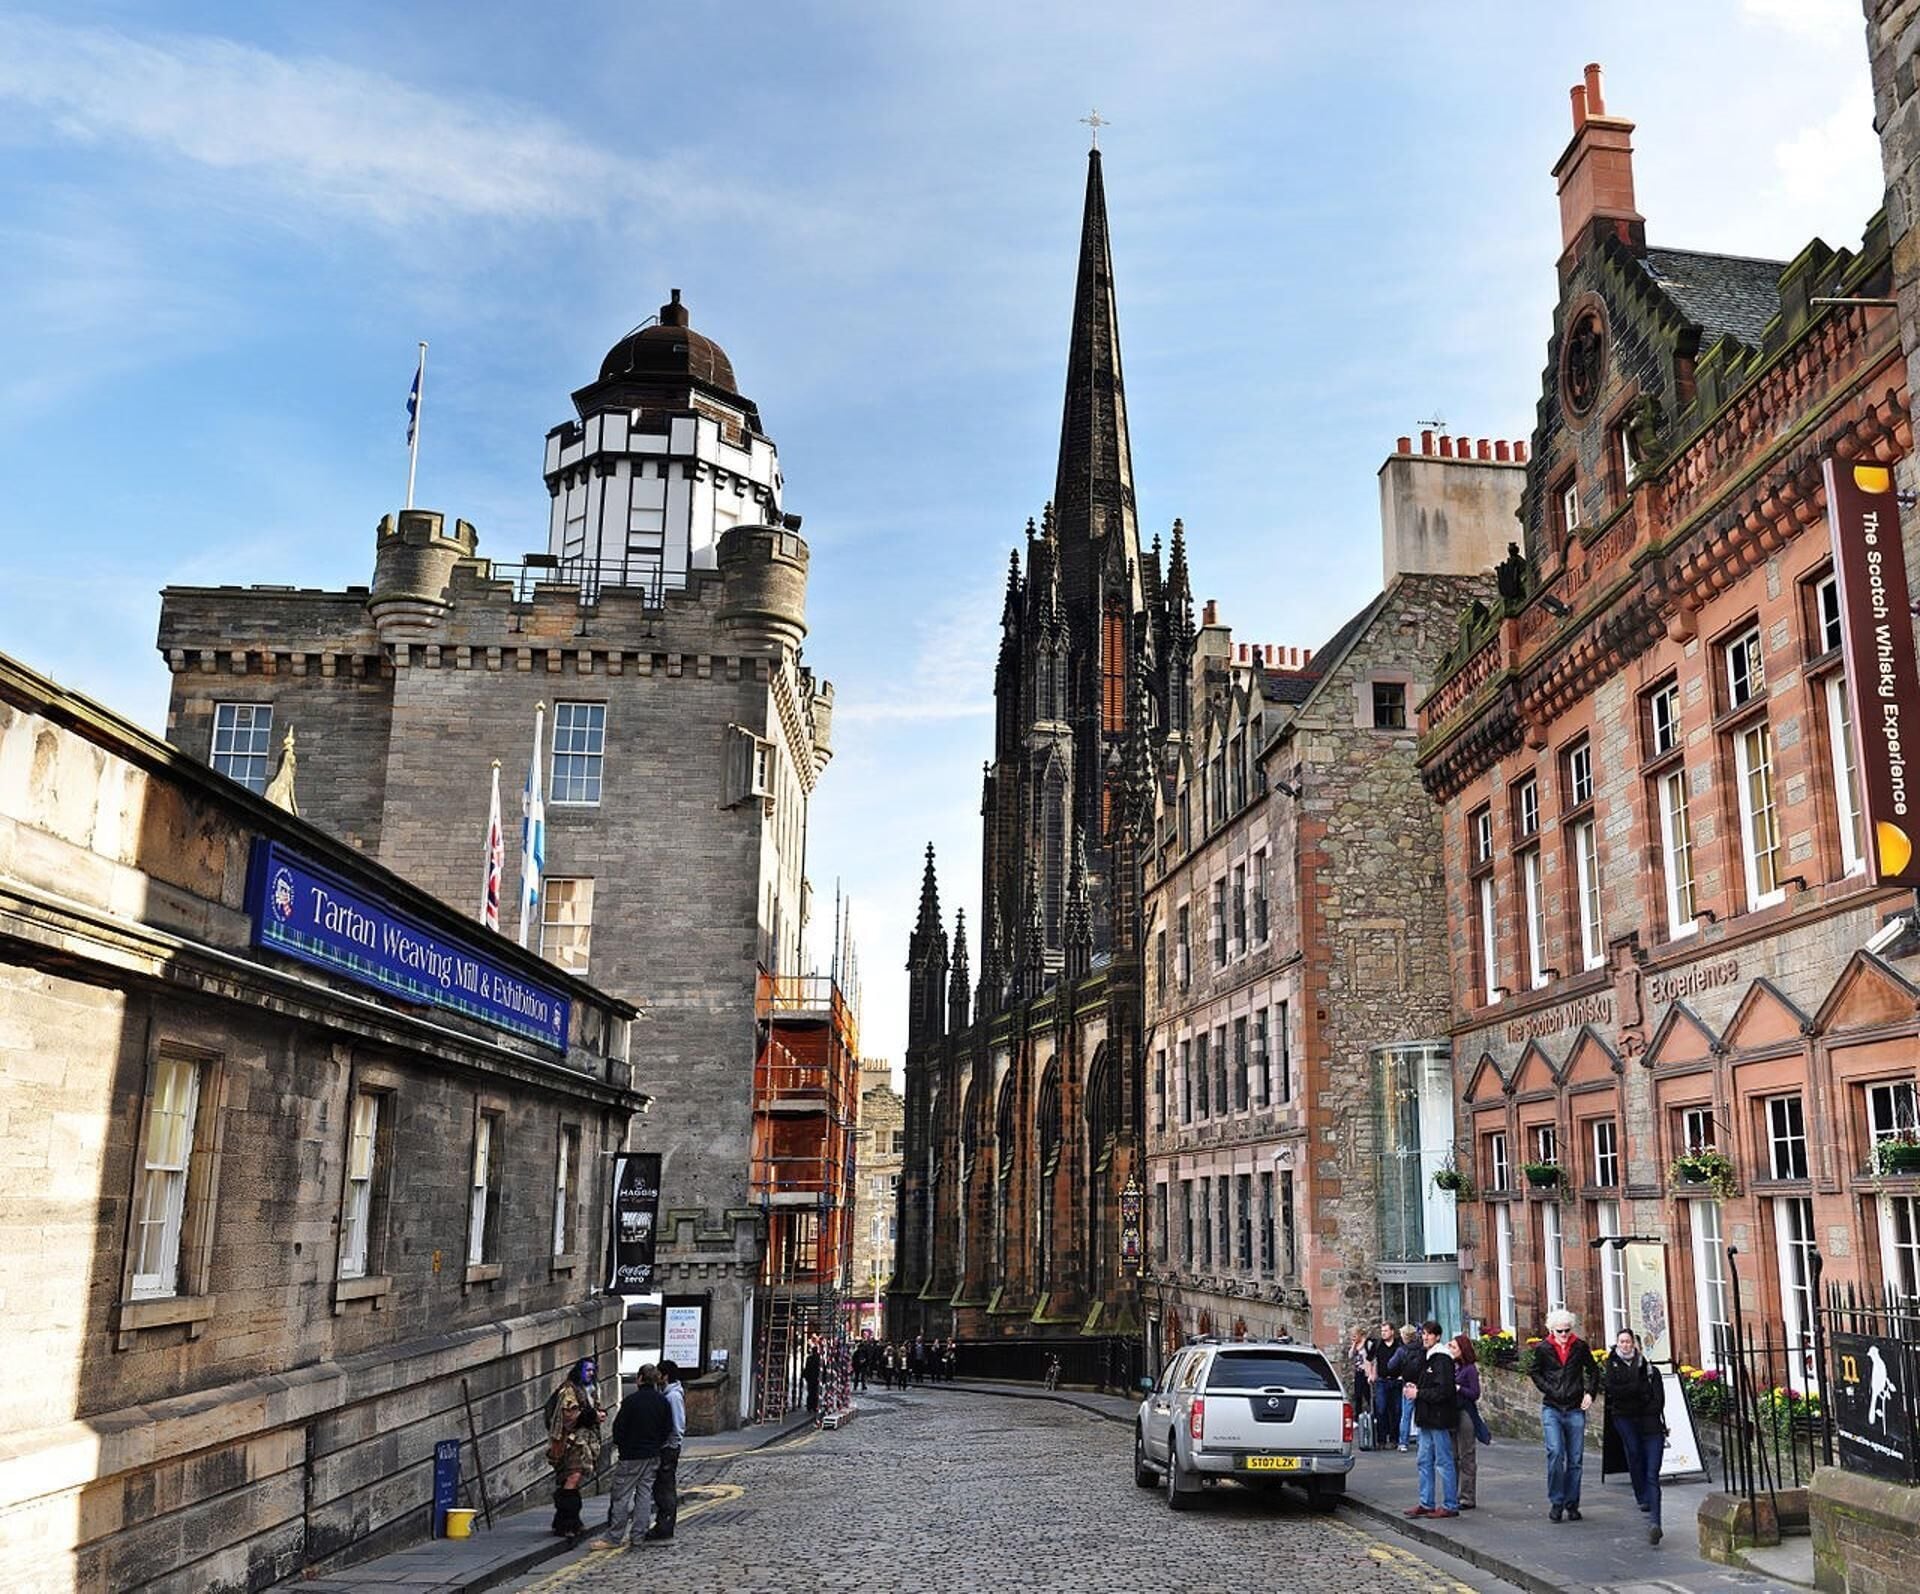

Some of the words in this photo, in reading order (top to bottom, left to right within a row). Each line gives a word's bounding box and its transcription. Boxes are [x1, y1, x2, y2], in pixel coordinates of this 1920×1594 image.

[1862, 511, 1880, 546] The
[1866, 551, 1889, 619] Scotch
[1874, 624, 1897, 698] Whisky
[1882, 703, 1908, 815] Experience
[311, 887, 376, 949] Tartan
[383, 923, 452, 988] Weaving
[455, 958, 479, 993] Mill
[480, 972, 490, 999] &
[493, 976, 548, 1023] Exhibition
[1651, 959, 1738, 1004] Experience
[1563, 996, 1611, 1027] Whisky
